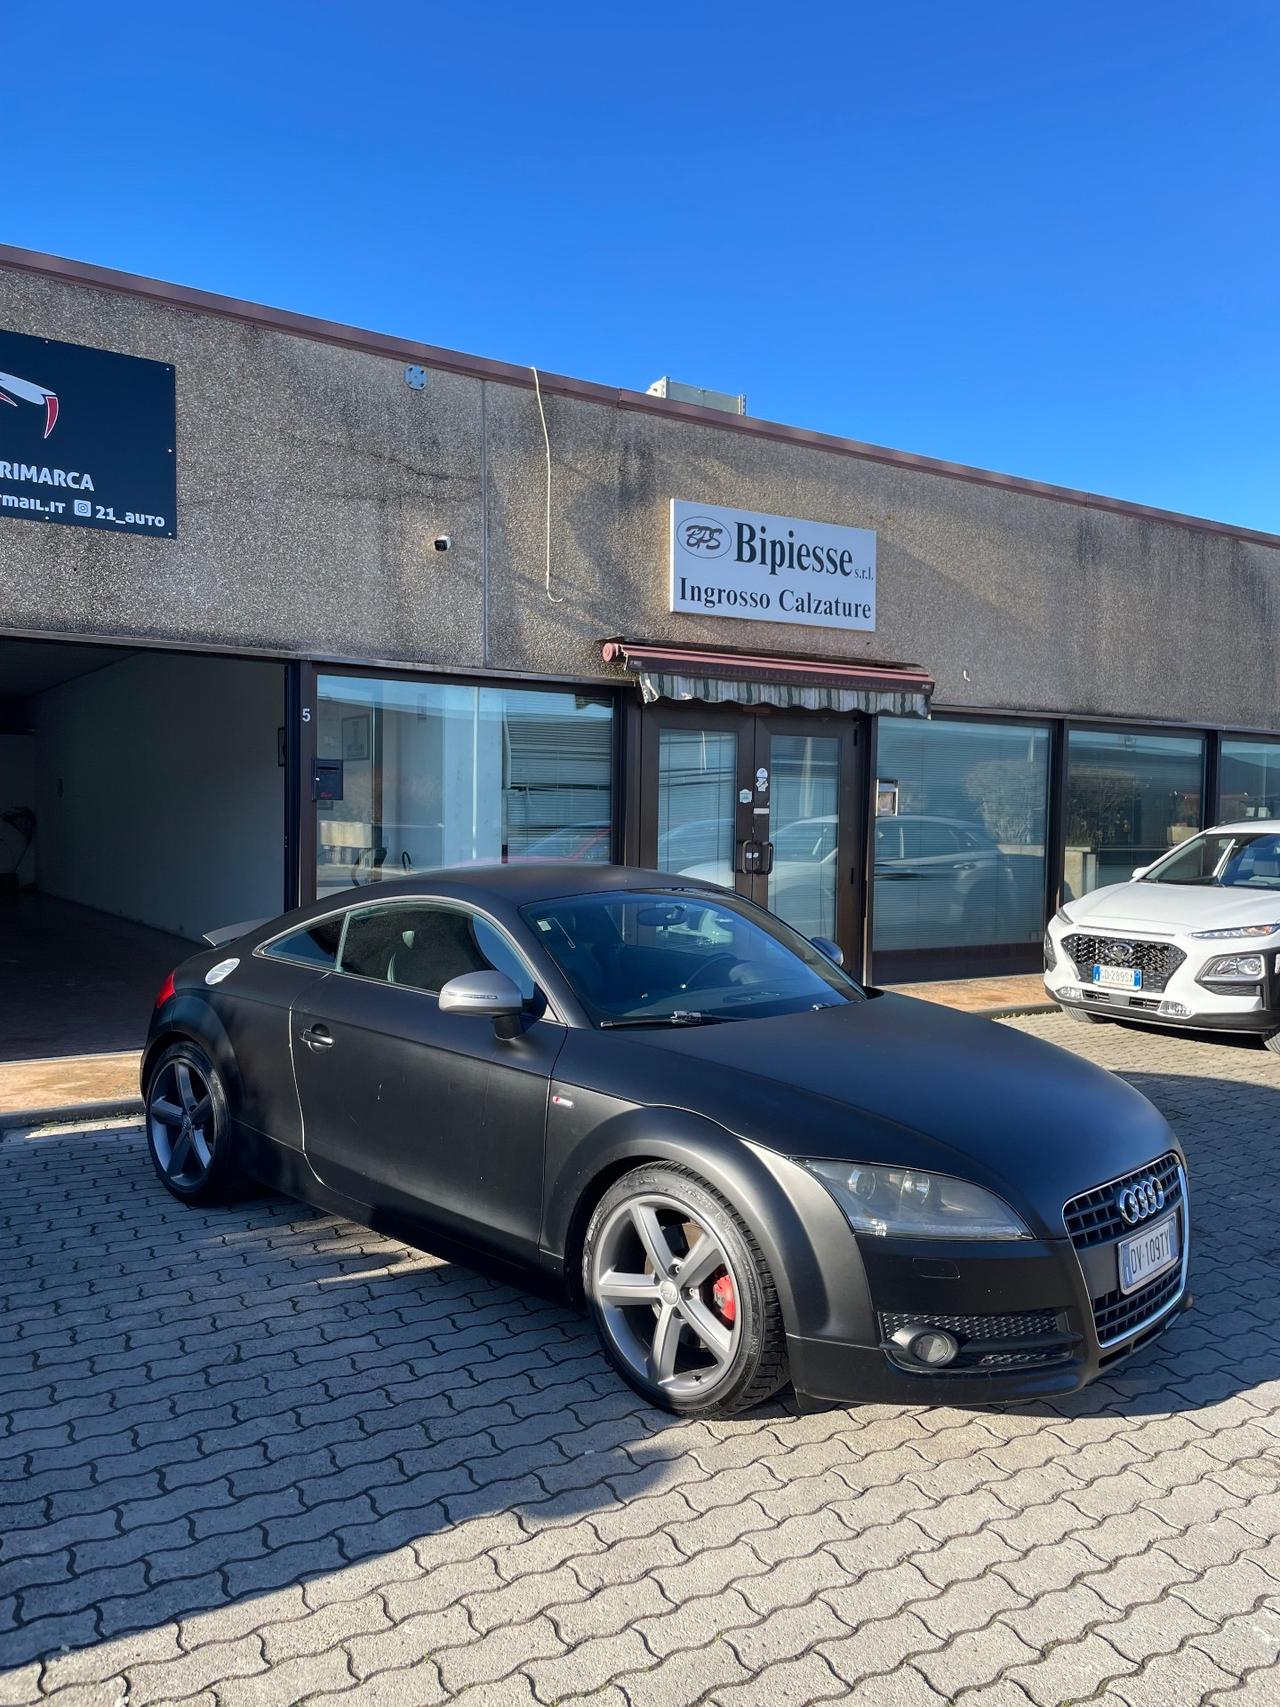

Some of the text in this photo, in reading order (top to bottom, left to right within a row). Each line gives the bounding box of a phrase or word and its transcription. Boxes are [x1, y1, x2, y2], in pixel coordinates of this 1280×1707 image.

[734, 522, 874, 580] Bipiesse s.r.l.
[680, 577, 872, 619] Ingrosso Calzature
[302, 708, 311, 722] 5
